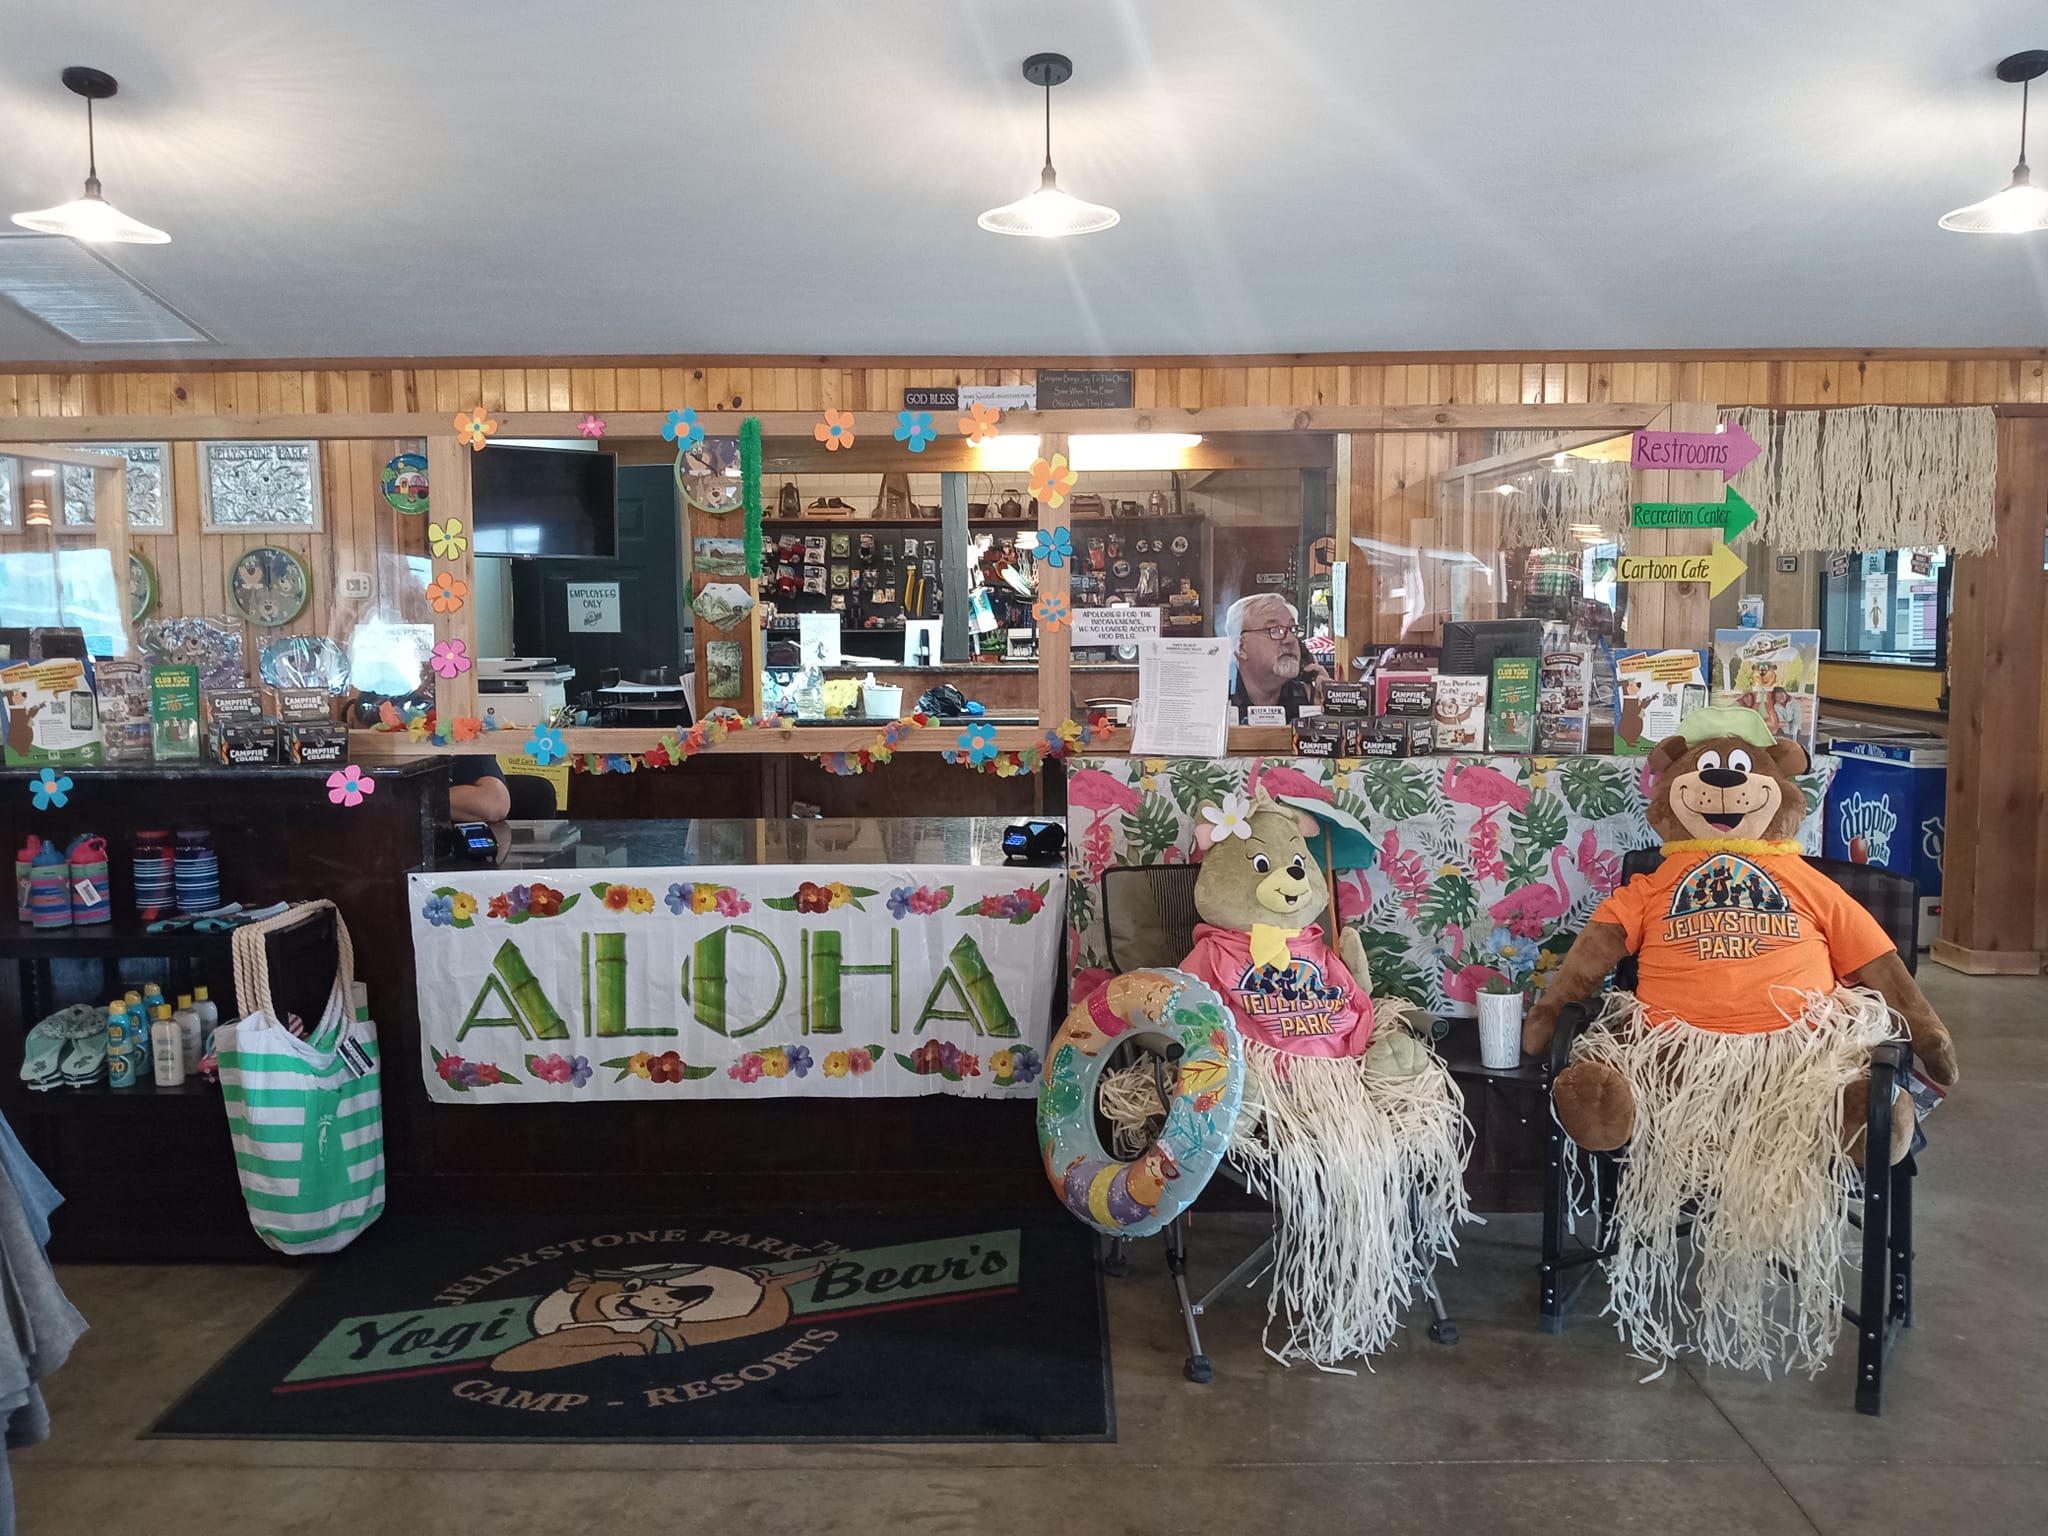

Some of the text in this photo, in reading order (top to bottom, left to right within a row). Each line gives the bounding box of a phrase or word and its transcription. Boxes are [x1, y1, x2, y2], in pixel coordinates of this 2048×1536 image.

[906, 393, 956, 405] GOD BLESS
[1637, 436, 1729, 464] Restrooms
[1634, 505, 1732, 526] Recreation Center
[1622, 559, 1710, 579] Cartoon Cafe
[570, 589, 616, 598] EMPLOYEES
[582, 600, 602, 608] ONLY
[154, 676, 190, 684] CLUB YOGI
[285, 696, 322, 706] CAMPFIRE
[1328, 690, 1360, 700] CAMPFIRE
[1392, 690, 1426, 700] CAMPFIRE
[215, 698, 252, 708] CAMPFIRE
[302, 746, 340, 756] CAMPFIRE
[1299, 741, 1332, 751] CAMPFIRE
[1362, 741, 1397, 751] CAMPFIRE
[230, 748, 268, 758] CAMPFIRE
[1868, 838, 1890, 866] dots
[1663, 911, 1800, 941] JELLYSTONE
[1698, 936, 1760, 961] PARK
[455, 924, 1021, 1041] ALOHA
[1280, 1012, 1335, 1038] PARK
[111, 1061, 125, 1073] 70
[434, 1229, 687, 1306] JELLYSTONE
[701, 1230, 812, 1261] PARK
[346, 1244, 1008, 1361] Yogi Bear's
[452, 1379, 590, 1412] CAMP
[642, 1327, 841, 1408] RESORTS
